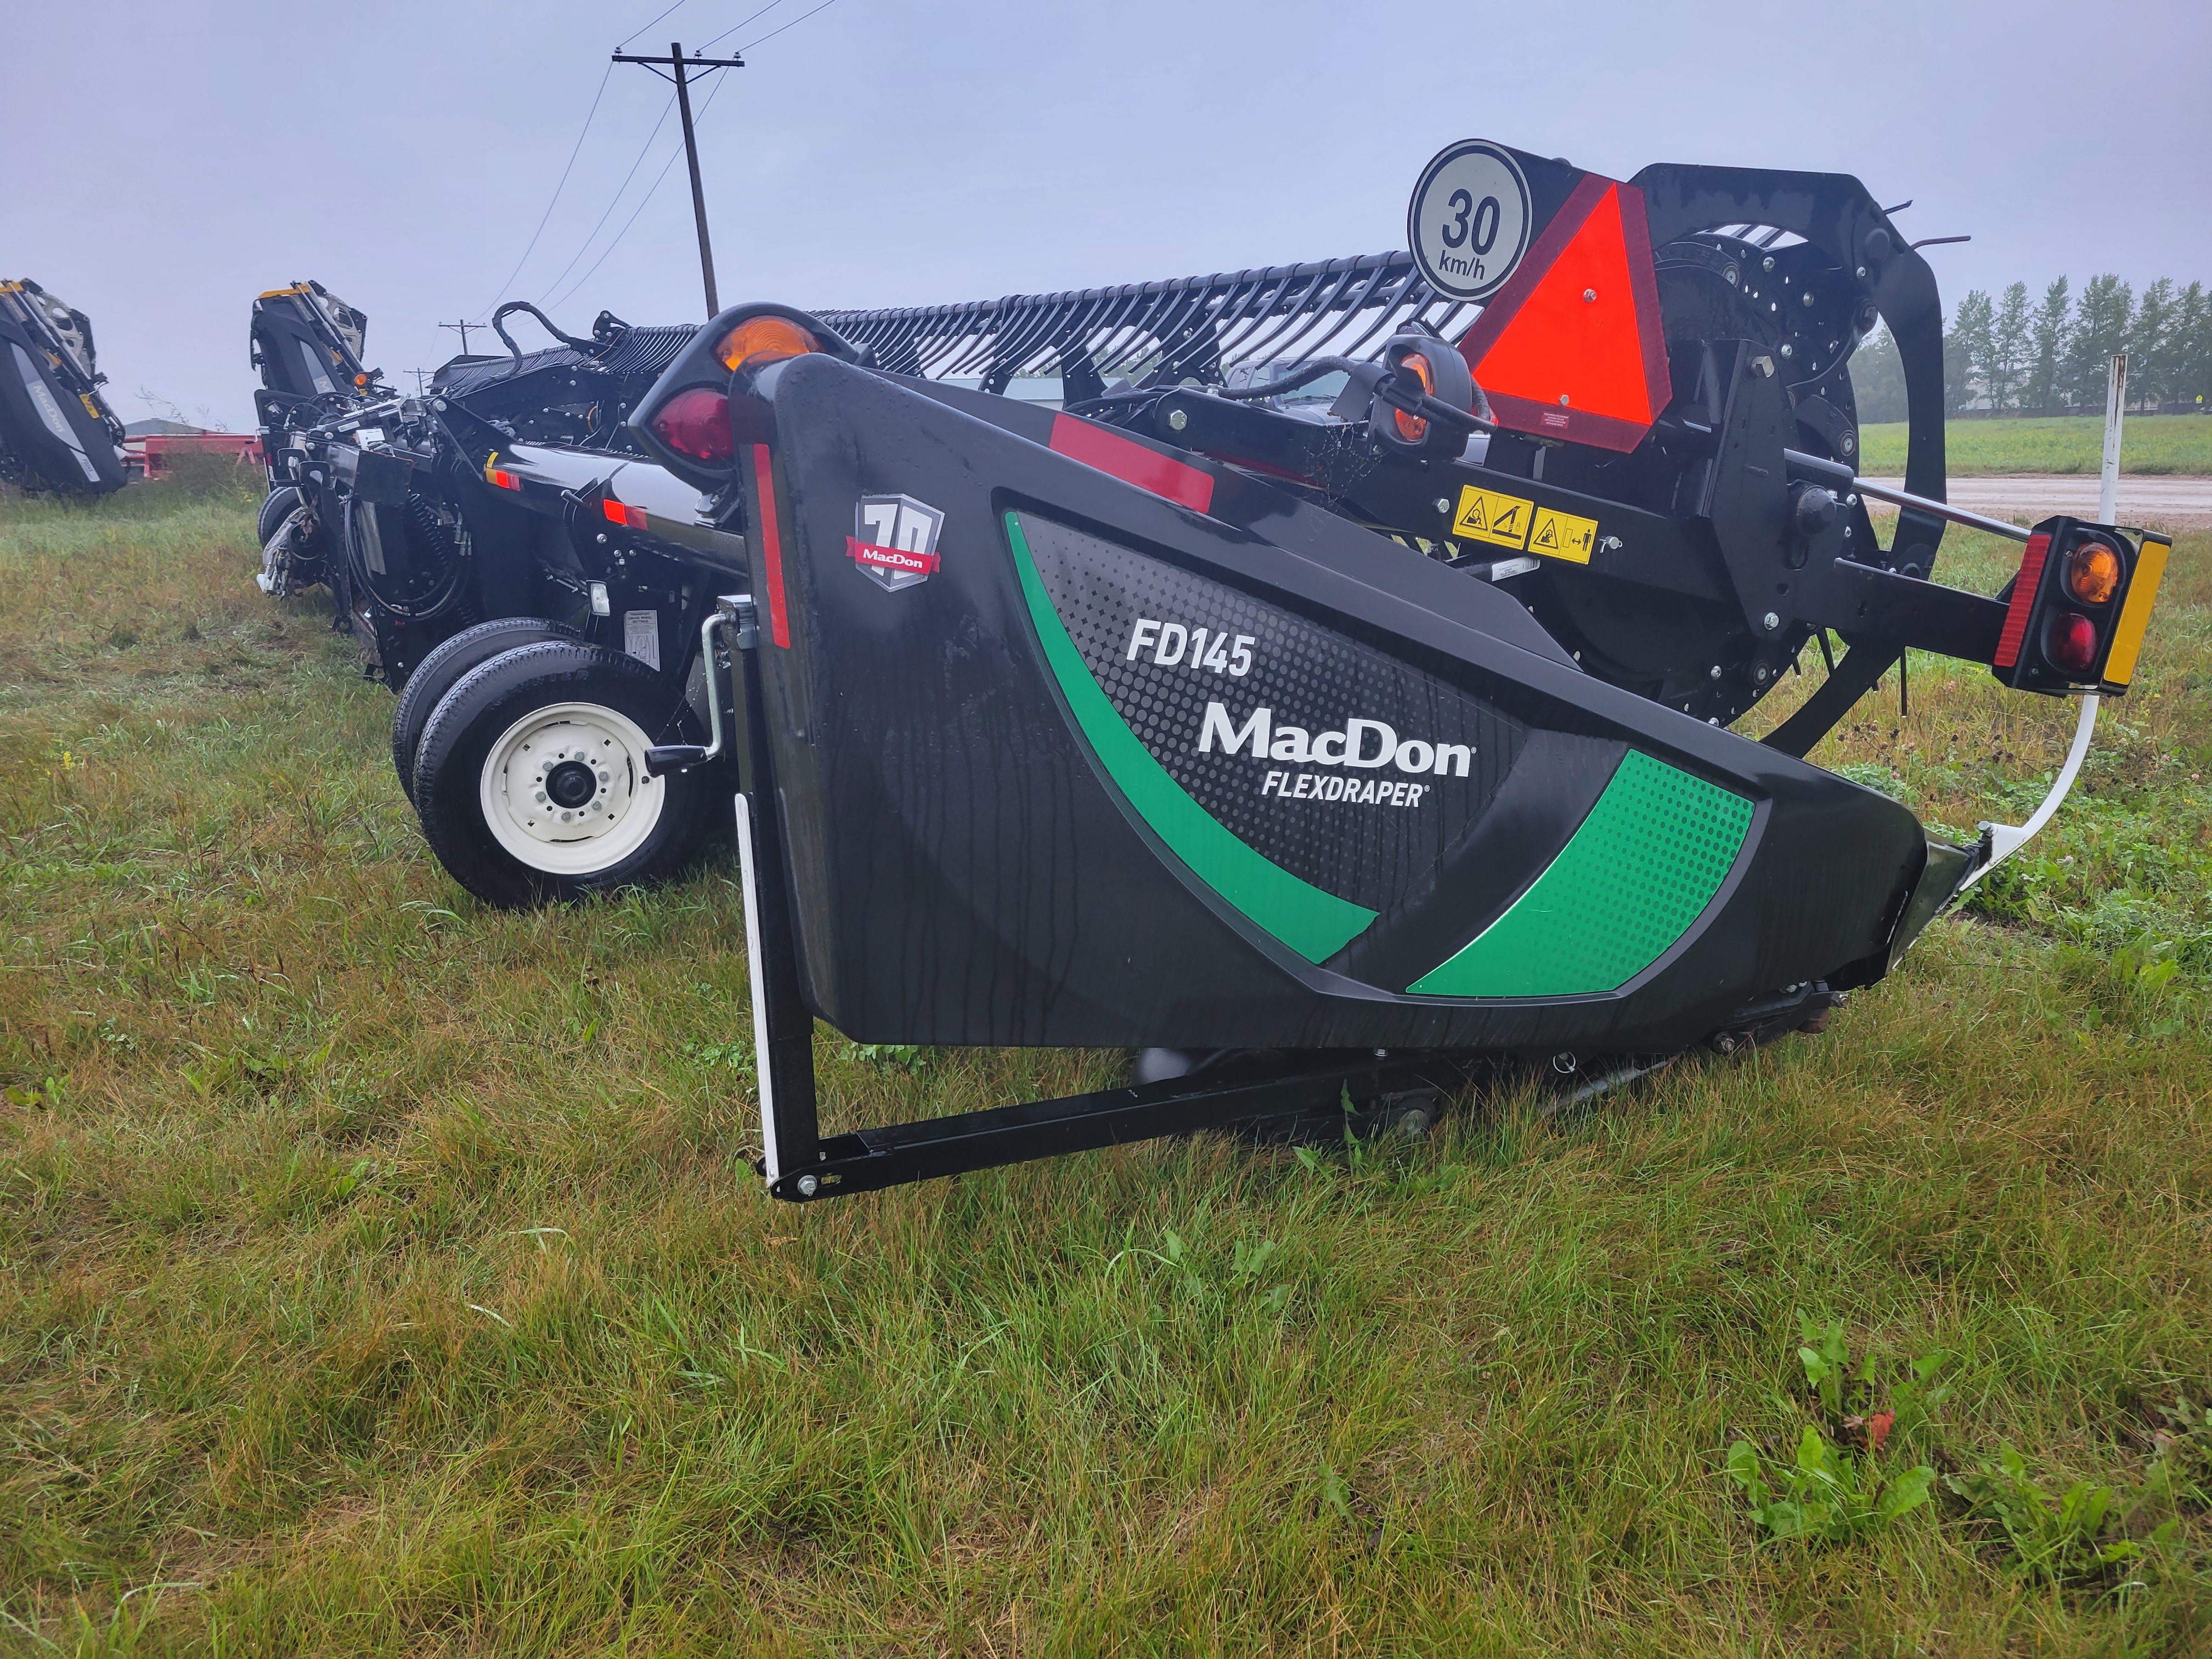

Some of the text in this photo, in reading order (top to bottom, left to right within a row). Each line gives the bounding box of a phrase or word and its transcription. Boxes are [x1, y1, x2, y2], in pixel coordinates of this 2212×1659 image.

[1442, 188, 1500, 256] 30
[1438, 249, 1485, 280] km/h
[33, 385, 64, 432] MacDon
[863, 548, 923, 568] MacDon
[864, 504, 933, 580] 70
[1126, 618, 1256, 676] FD145
